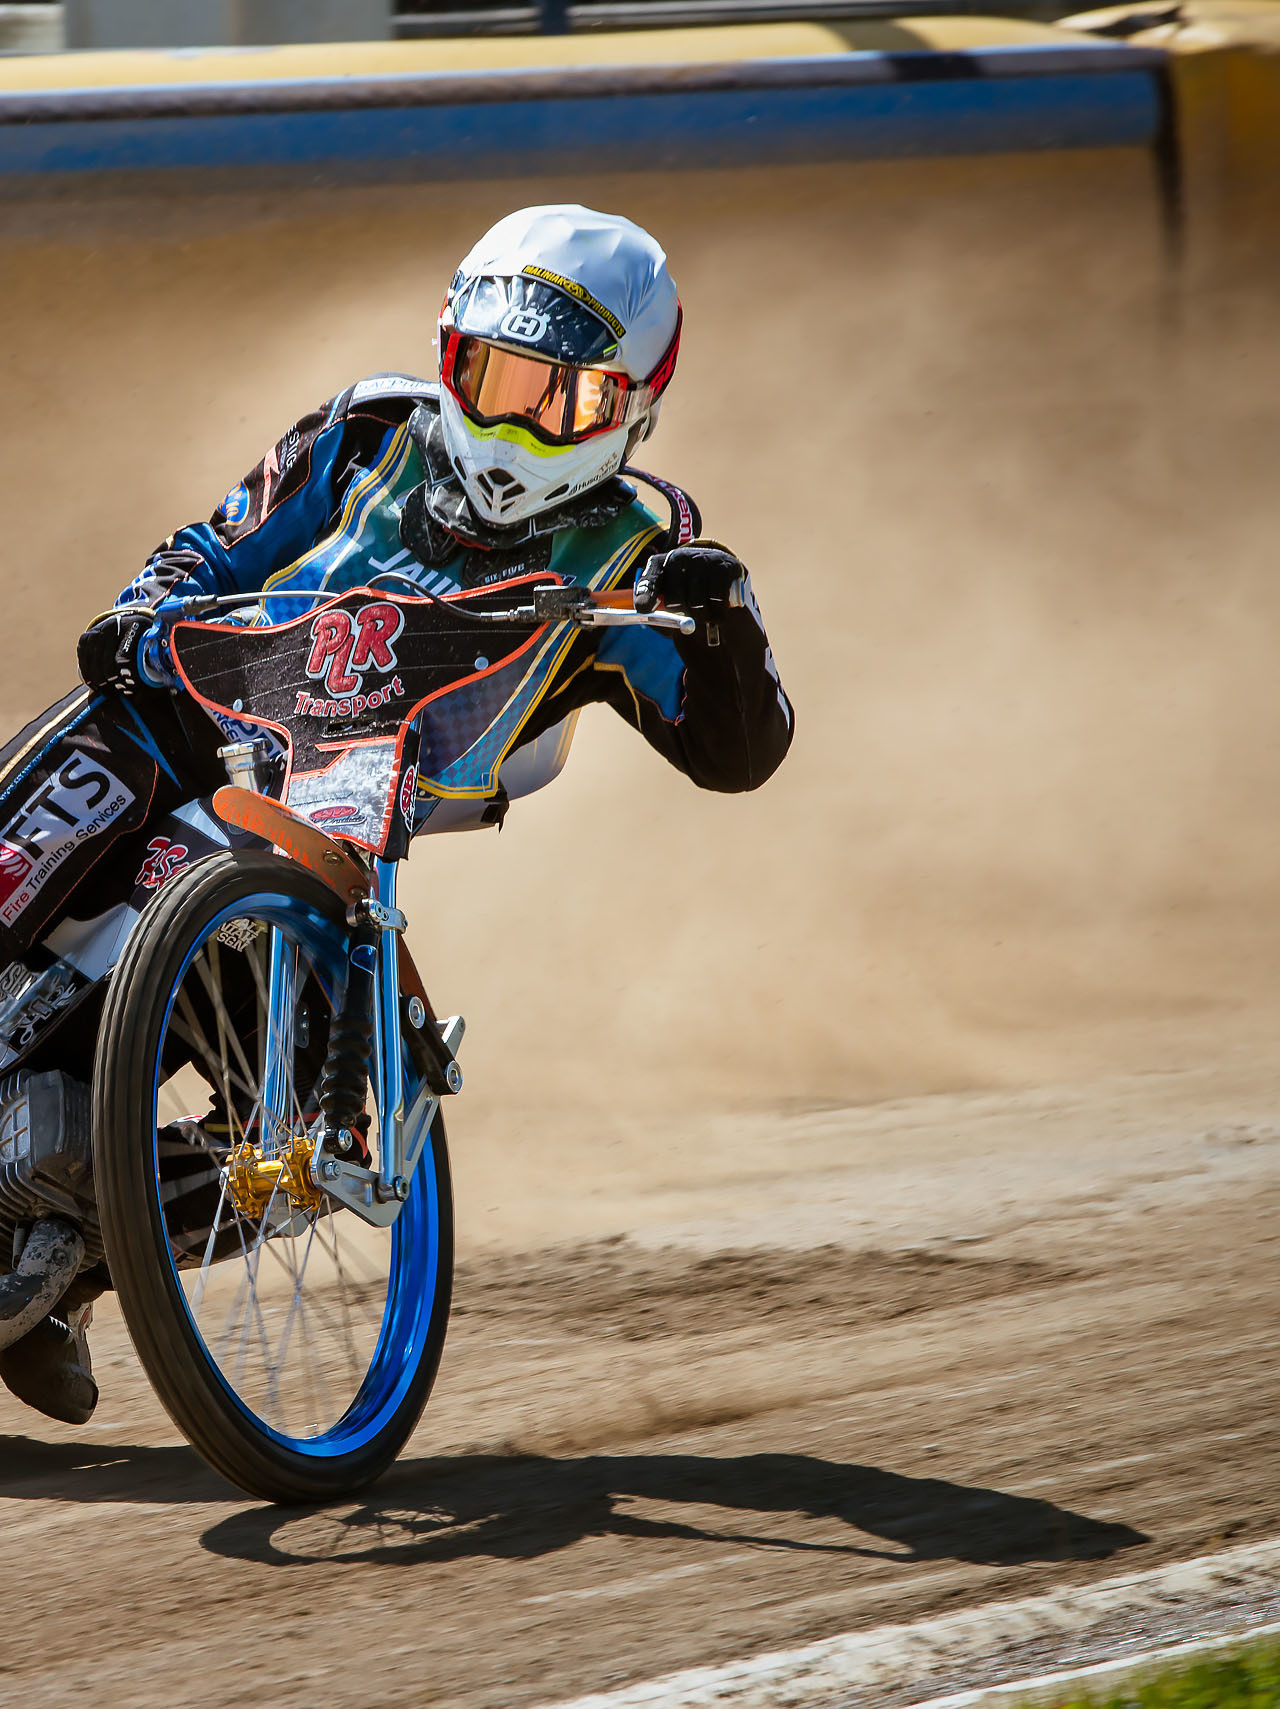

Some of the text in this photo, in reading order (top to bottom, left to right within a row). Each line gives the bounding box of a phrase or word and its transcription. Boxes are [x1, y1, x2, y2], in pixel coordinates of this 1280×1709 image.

[524, 265, 626, 337] MALINIAK PRODUCTS
[294, 675, 406, 718] Transport
[2, 757, 111, 861] FTS
[2, 889, 30, 922] Fire
[25, 840, 76, 892] Training
[75, 794, 127, 842] Services
